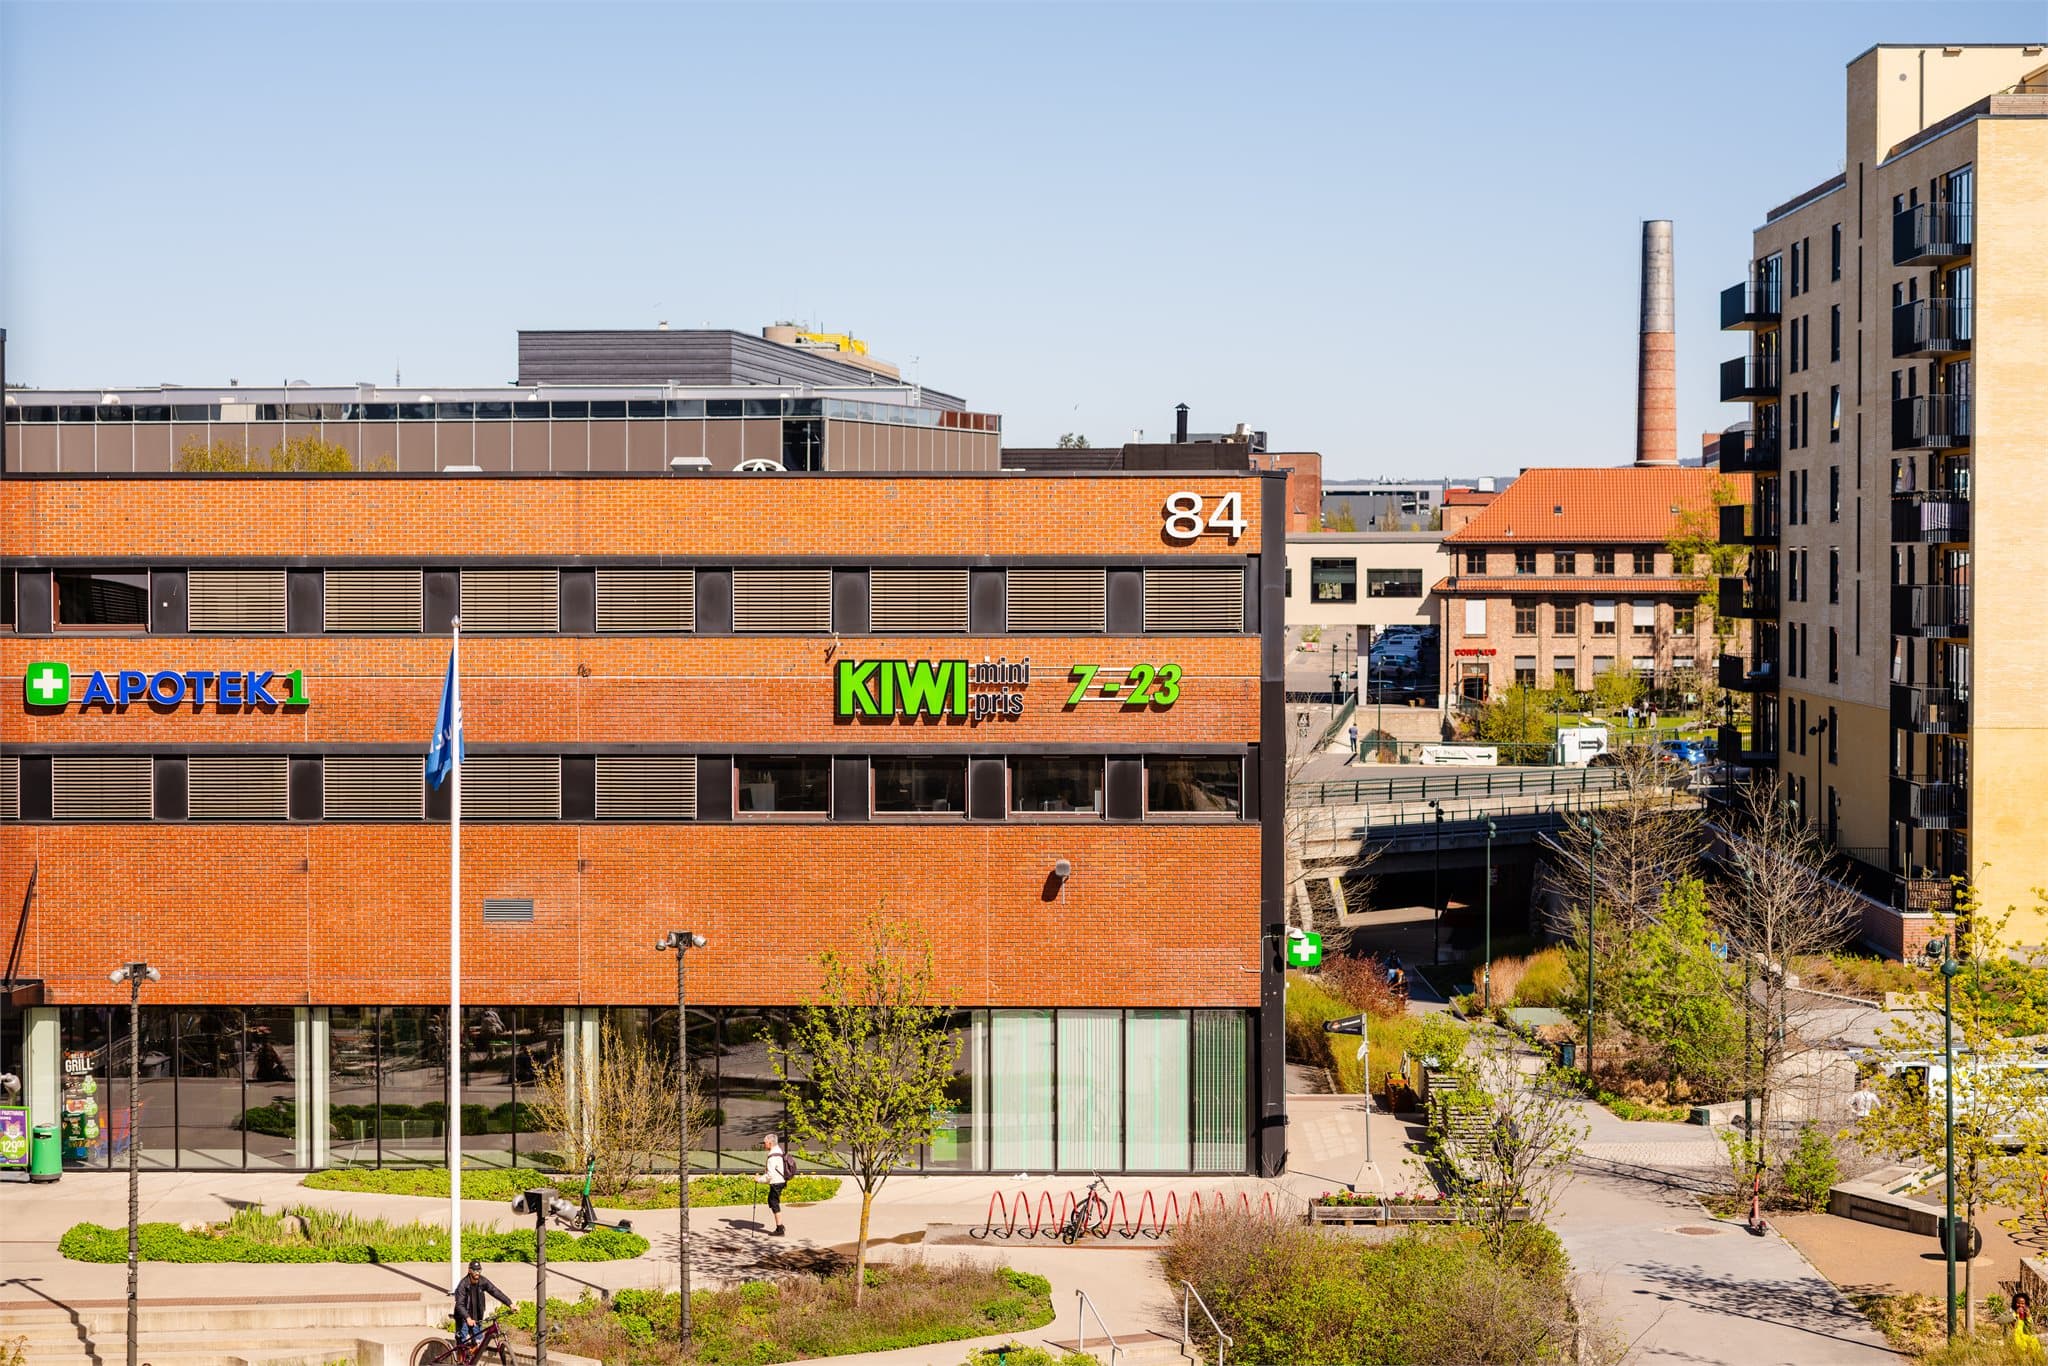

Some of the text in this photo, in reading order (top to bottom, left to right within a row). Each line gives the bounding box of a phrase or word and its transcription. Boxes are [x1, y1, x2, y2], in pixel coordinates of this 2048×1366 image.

[1164, 491, 1248, 539] 84
[82, 669, 311, 706] APOTEK 1
[837, 659, 969, 716] KIWI
[974, 657, 1031, 685] mini
[974, 687, 1025, 721] pris
